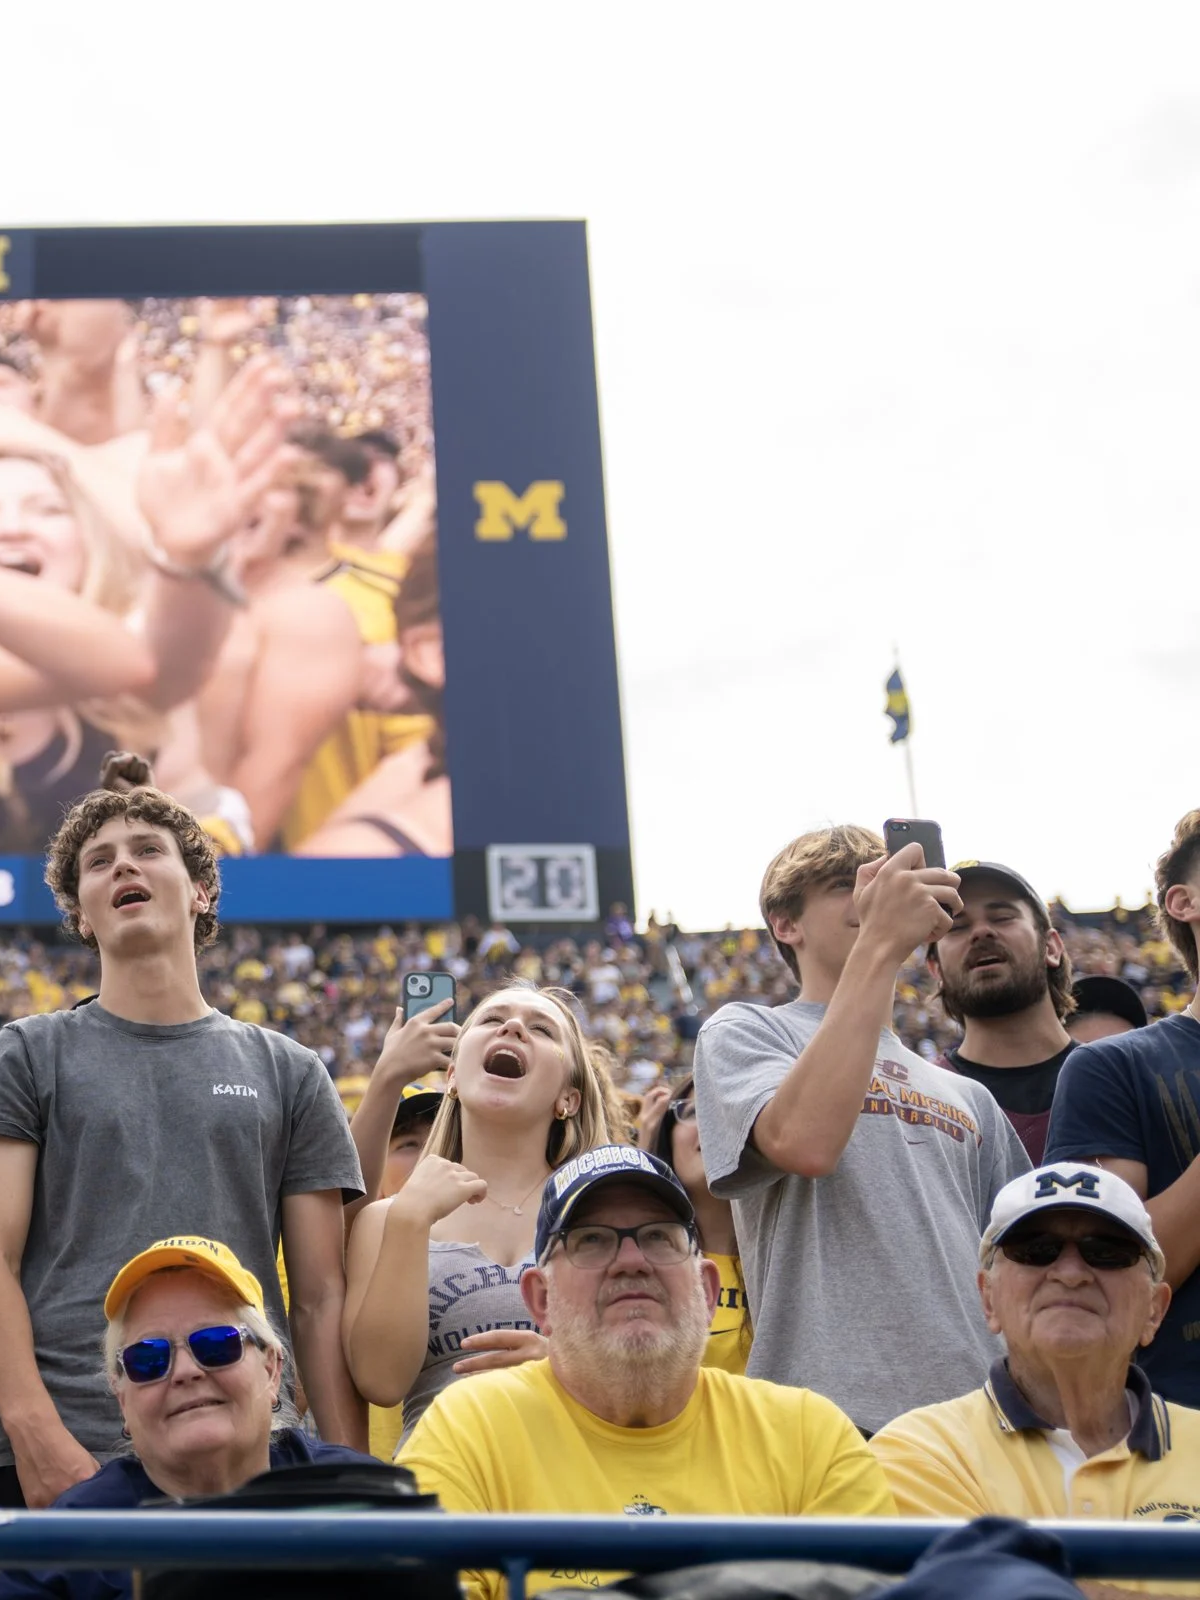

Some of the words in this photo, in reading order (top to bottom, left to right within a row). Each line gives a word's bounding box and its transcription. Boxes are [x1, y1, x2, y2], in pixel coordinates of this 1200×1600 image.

[473, 480, 567, 542] M
[213, 1084, 258, 1099] KATIN
[867, 1077, 897, 1101] AL
[860, 1101, 958, 1137] NIERSITY
[1035, 1171, 1100, 1199] M
[1158, 1502, 1170, 1510] to
[1171, 1502, 1190, 1511] the
